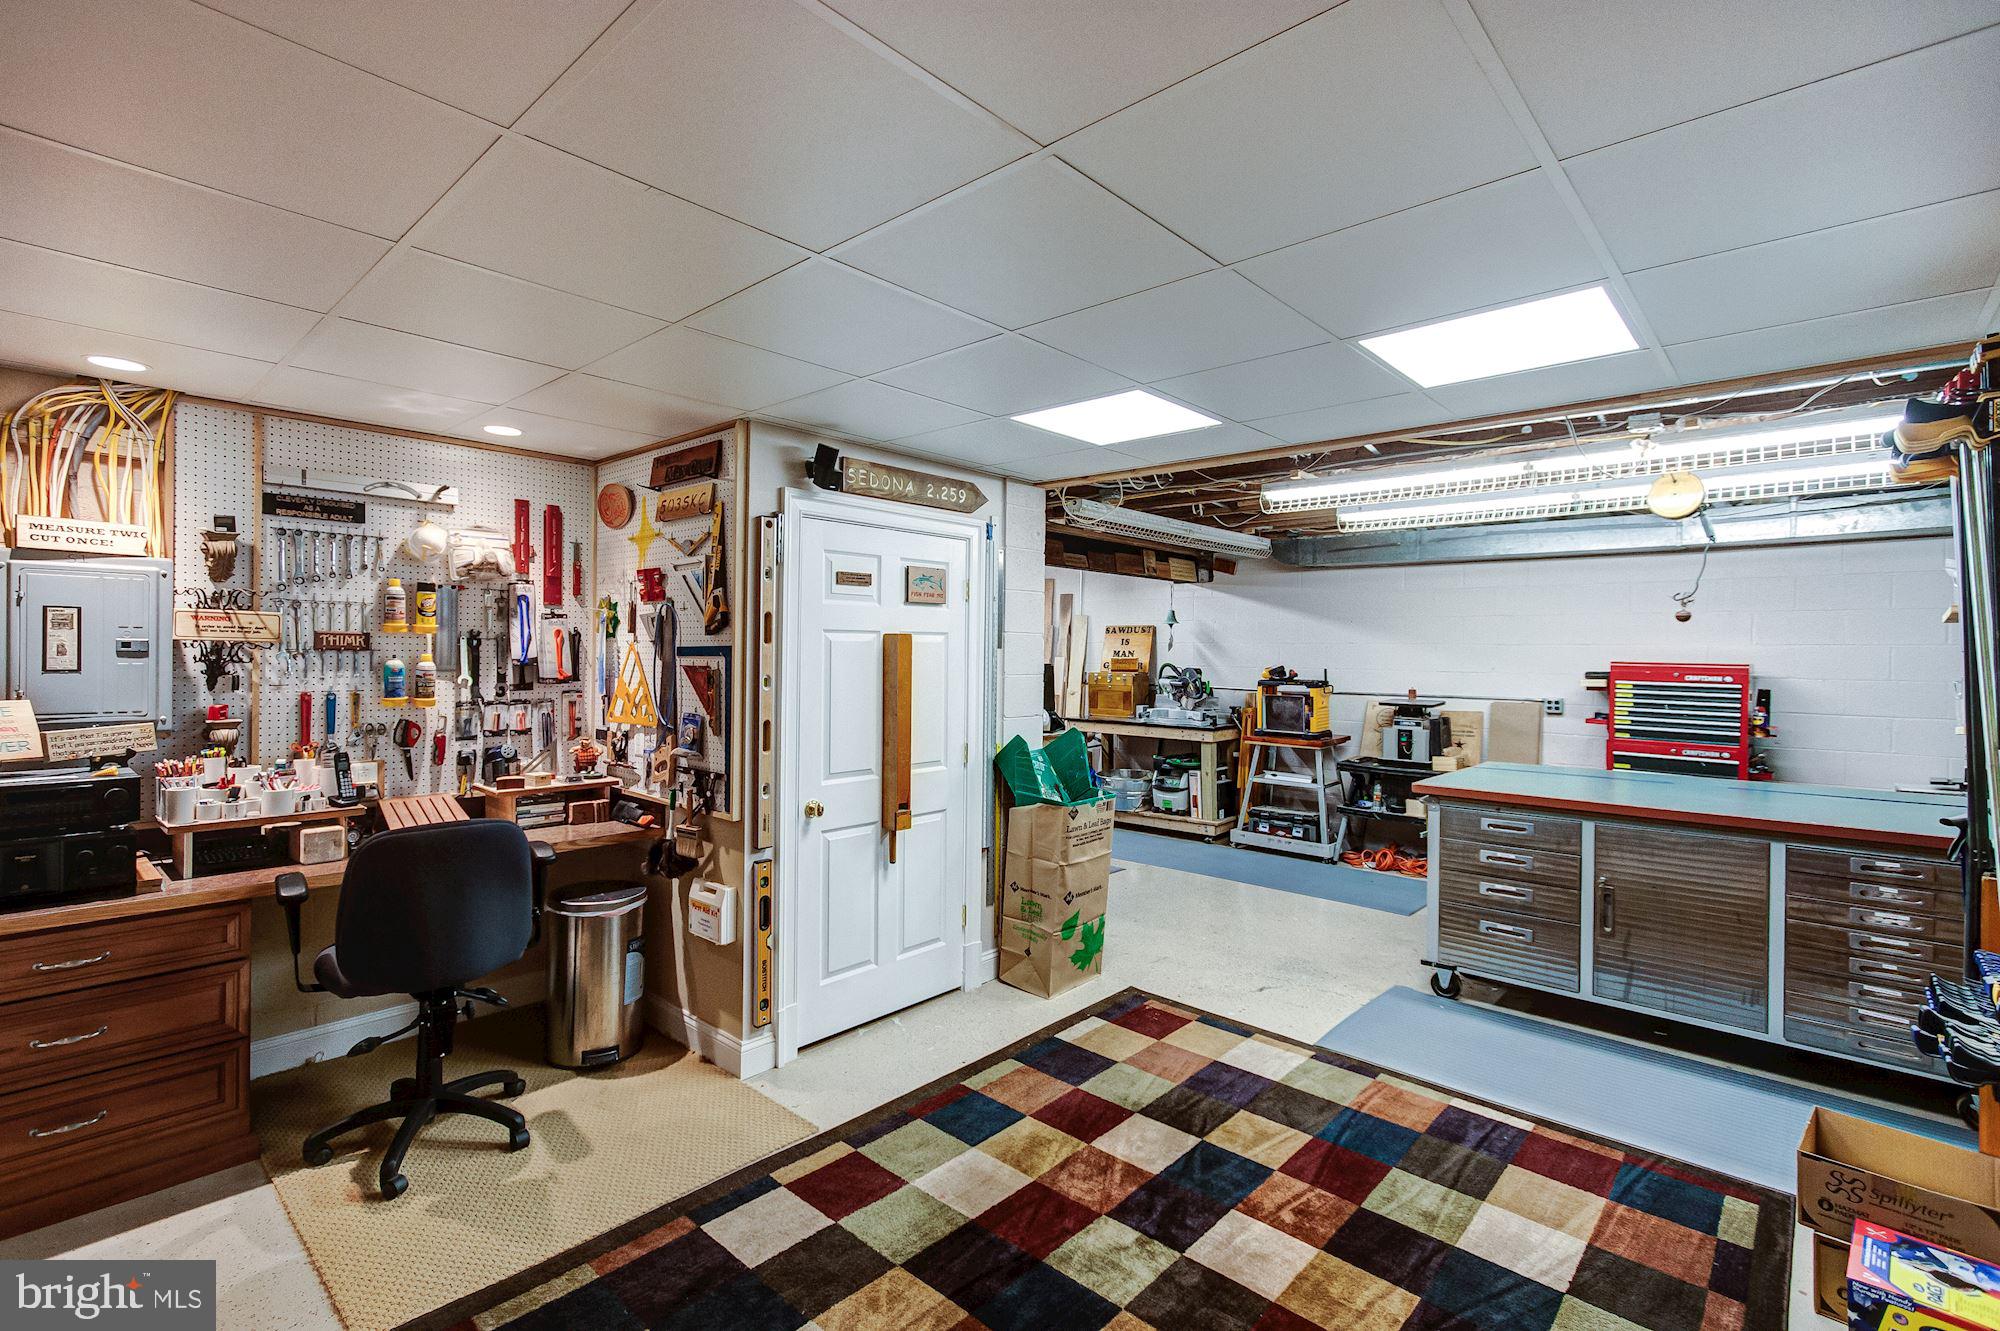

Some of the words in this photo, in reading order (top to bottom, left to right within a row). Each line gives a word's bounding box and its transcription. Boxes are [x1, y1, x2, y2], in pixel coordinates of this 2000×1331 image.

[846, 467, 915, 494] SEDONA
[926, 483, 967, 503] 2.259
[275, 494, 316, 505] CLEVERLY
[275, 508, 328, 520] RESPONSIBLE
[329, 513, 354, 522] ADULT
[28, 522, 106, 536] MEASURE
[29, 533, 61, 543] CUT
[65, 536, 114, 547] ONCE!
[1105, 625, 1153, 634] SAWDUST
[319, 634, 367, 648] THIMK
[1120, 638, 1130, 646] IS
[1112, 650, 1136, 658] MAN
[1066, 825, 1083, 833] Lawn
[1852, 1280, 1869, 1291] New
[1870, 1286, 1886, 1298] with
[1887, 1293, 1913, 1307] Handy
